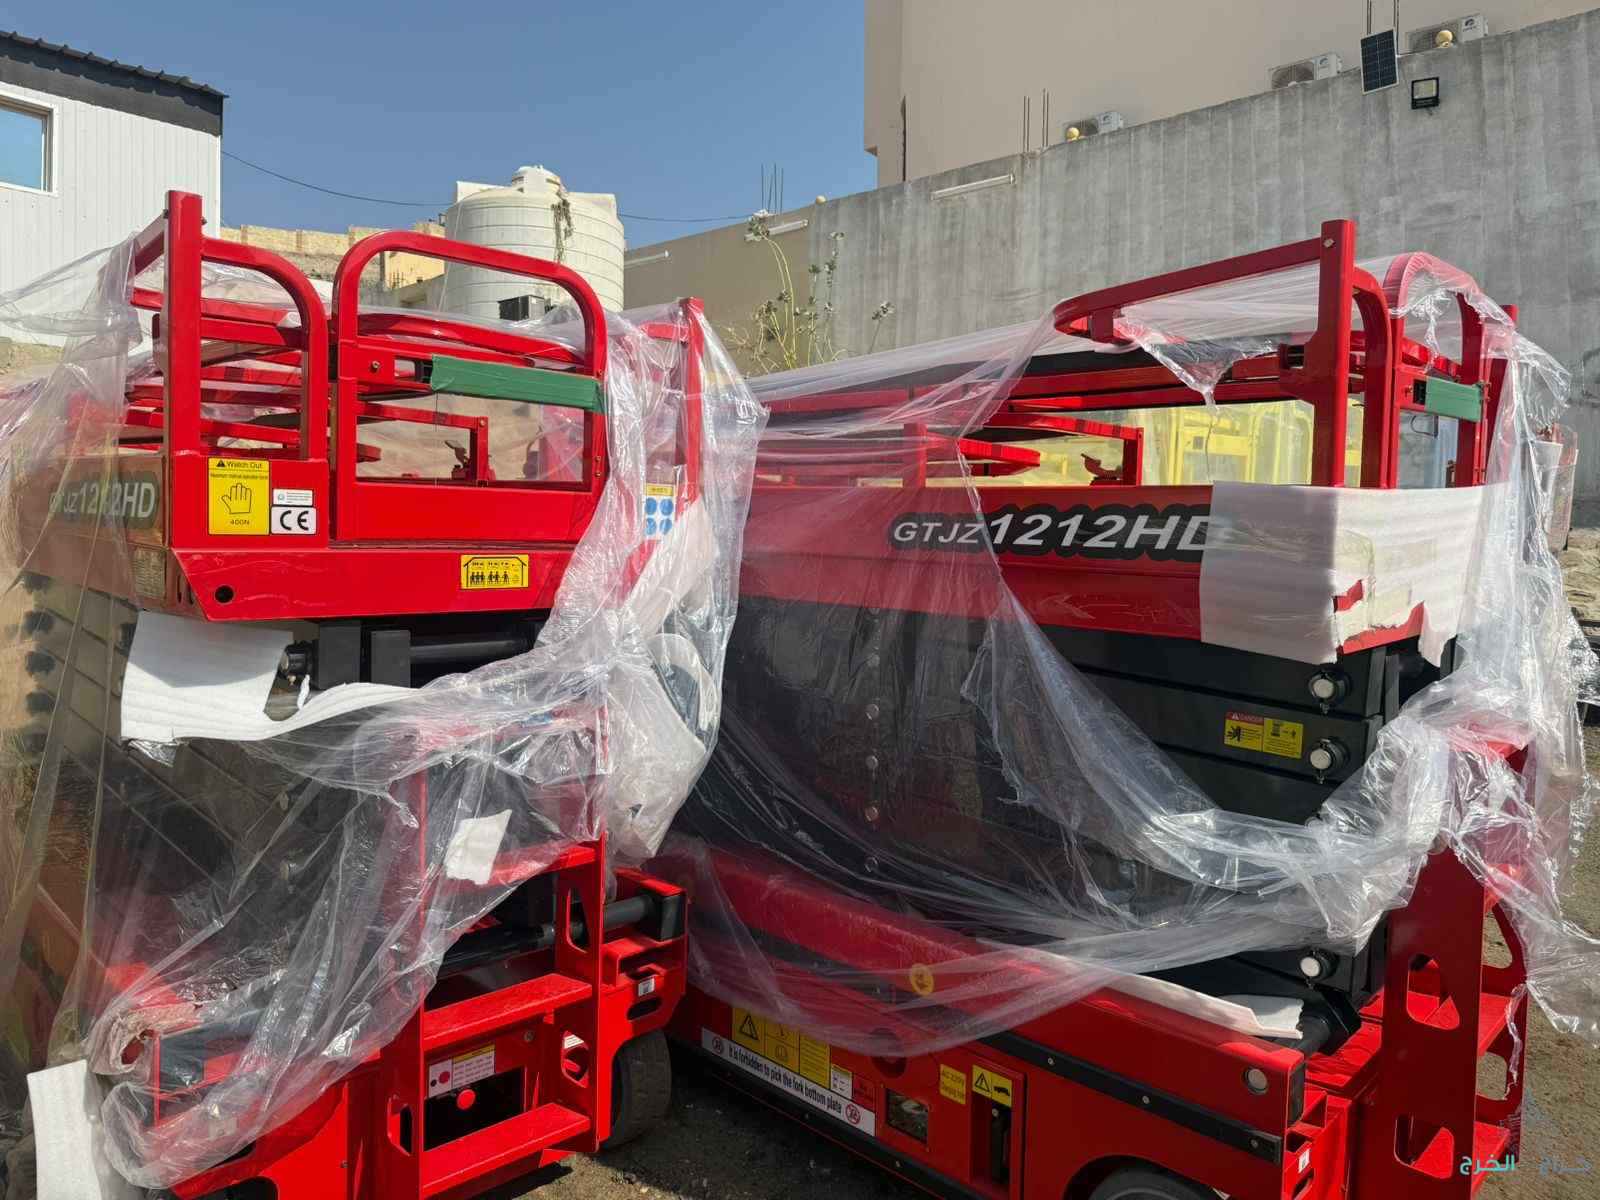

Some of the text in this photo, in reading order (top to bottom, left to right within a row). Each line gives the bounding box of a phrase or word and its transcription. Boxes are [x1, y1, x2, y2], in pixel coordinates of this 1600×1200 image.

[737, 1045, 763, 1073] forbidden
[764, 1062, 770, 1076] to
[771, 1066, 782, 1082] pick
[782, 1070, 792, 1088] the
[793, 1077, 804, 1092] fork
[805, 1084, 826, 1107] bottom
[827, 1094, 842, 1114] plate
